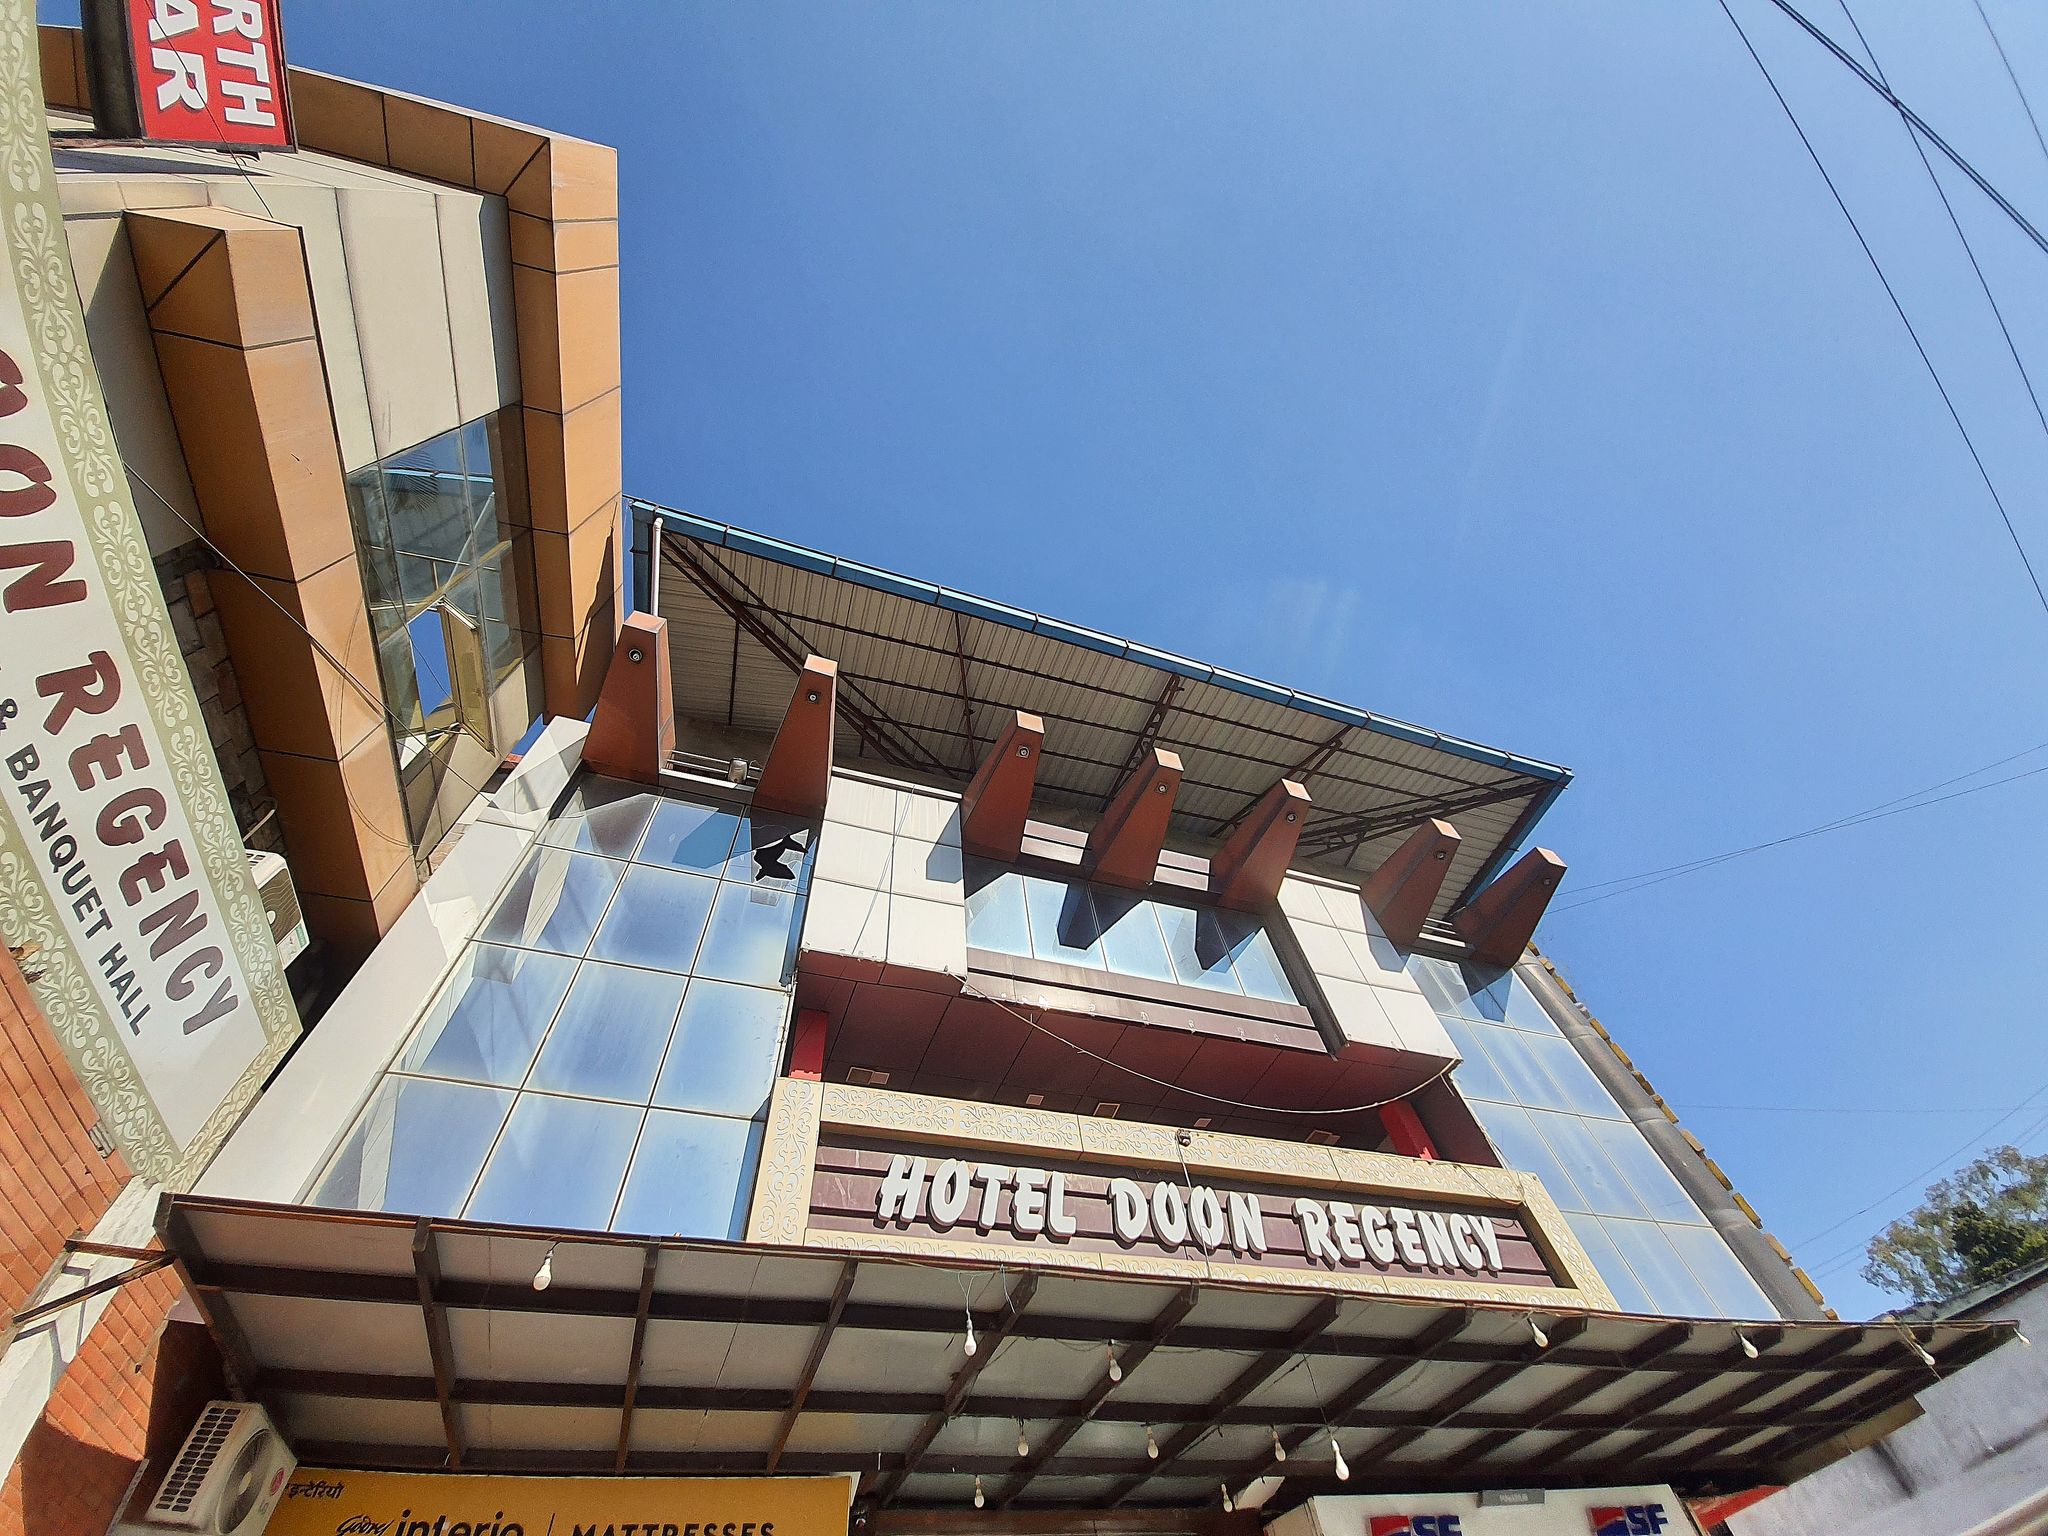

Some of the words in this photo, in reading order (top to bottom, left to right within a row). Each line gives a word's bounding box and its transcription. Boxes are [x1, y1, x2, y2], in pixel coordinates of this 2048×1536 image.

[5, 742, 113, 941] BANQUET
[99, 942, 152, 1037] HALL
[35, 650, 239, 1036] REGENCY
[875, 1153, 1077, 1238] HOTEL
[1107, 1177, 1268, 1253] DOON
[1291, 1197, 1503, 1272] REGENCY
[395, 1509, 525, 1536] interio
[1625, 1503, 1669, 1536] SF
